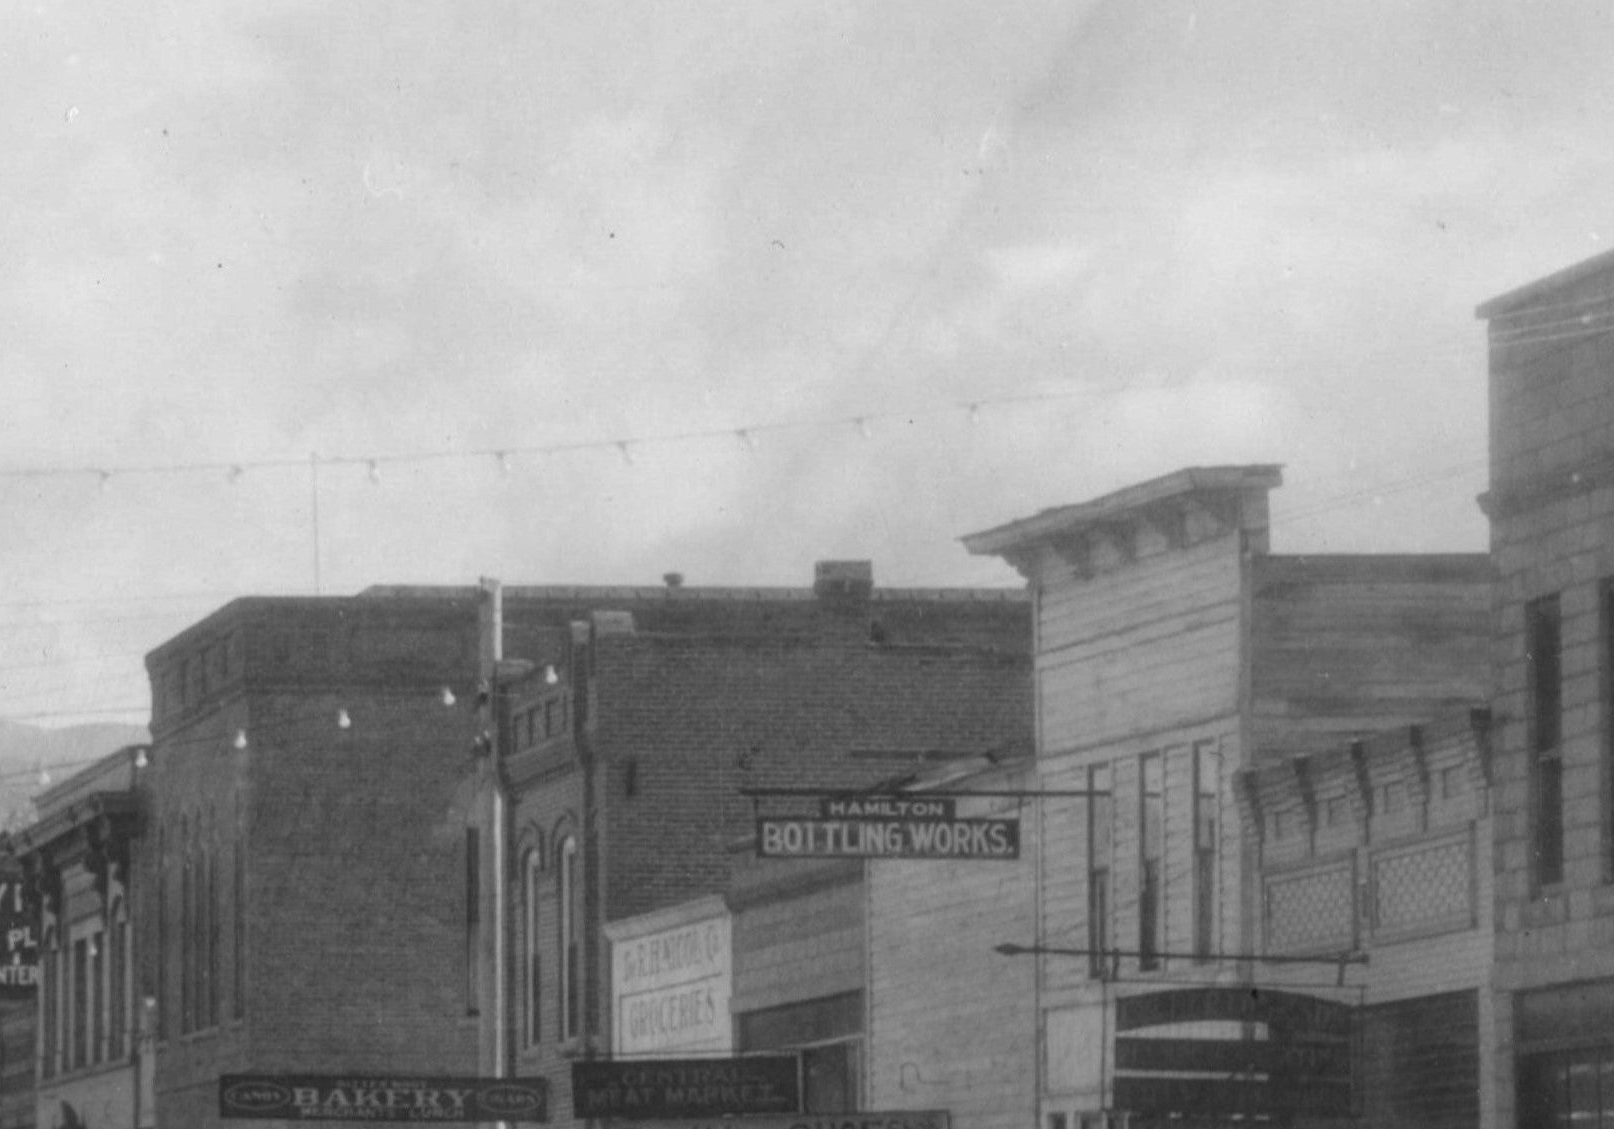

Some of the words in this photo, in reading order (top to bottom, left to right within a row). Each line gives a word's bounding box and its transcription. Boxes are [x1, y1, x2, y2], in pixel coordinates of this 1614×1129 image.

[829, 801, 944, 817] HAMILTON
[763, 821, 903, 854] BOTTLING
[909, 822, 1016, 854] WORKS.
[293, 1086, 474, 1107] BAKERY
